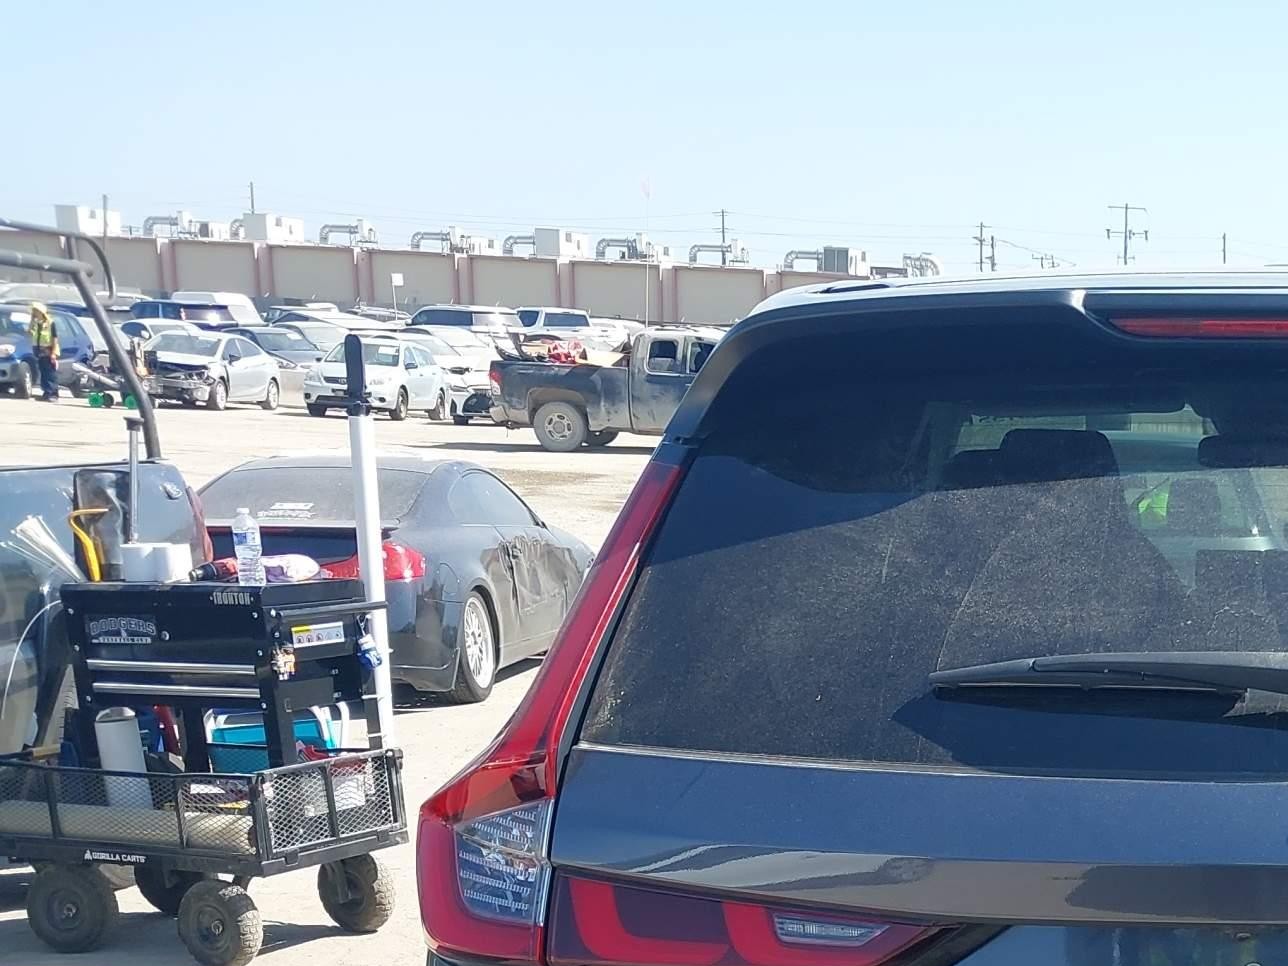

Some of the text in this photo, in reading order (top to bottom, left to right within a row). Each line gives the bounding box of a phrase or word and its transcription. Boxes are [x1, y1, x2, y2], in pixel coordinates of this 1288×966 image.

[89, 617, 157, 635] DODGERS
[92, 851, 147, 863] GORILLA CARTS
